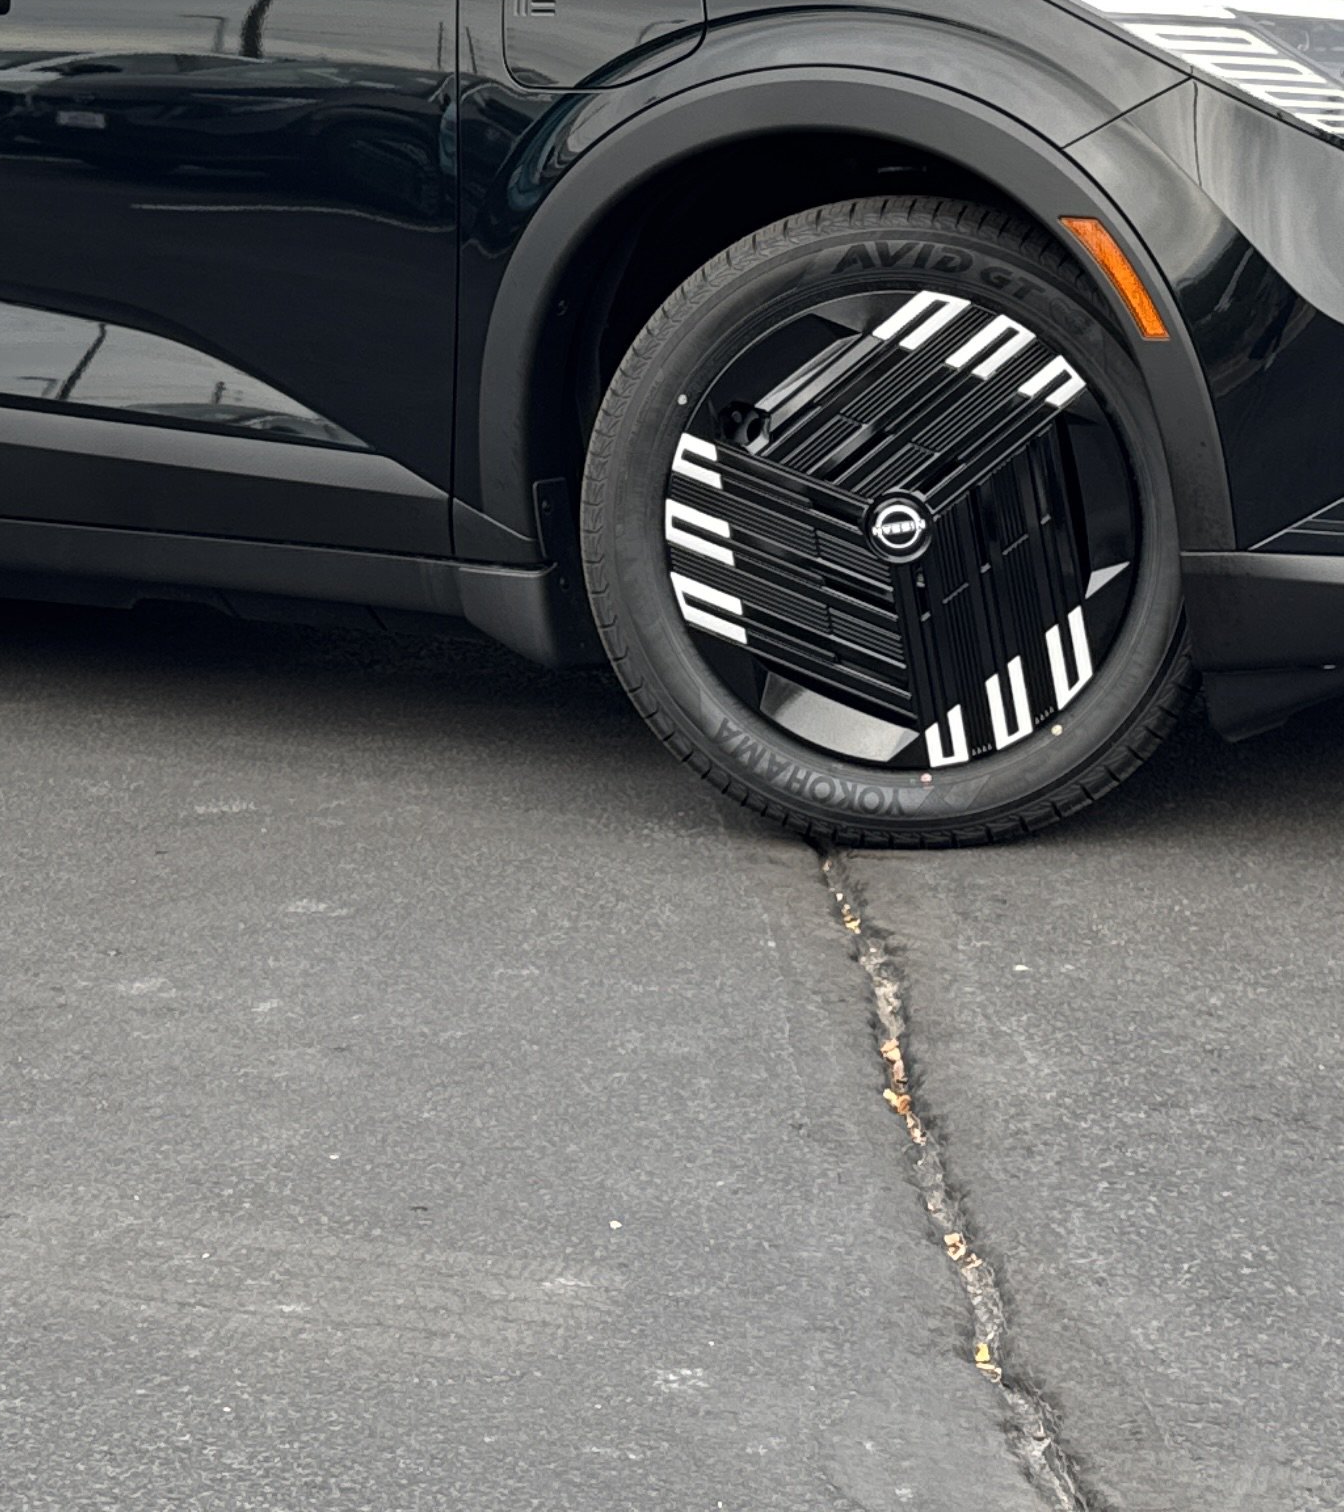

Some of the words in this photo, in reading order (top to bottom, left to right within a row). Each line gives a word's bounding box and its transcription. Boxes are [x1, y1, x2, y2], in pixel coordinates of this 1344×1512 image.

[831, 240, 973, 275] AVID
[979, 265, 1047, 300] GT
[714, 717, 903, 816] YOKOHAMA
